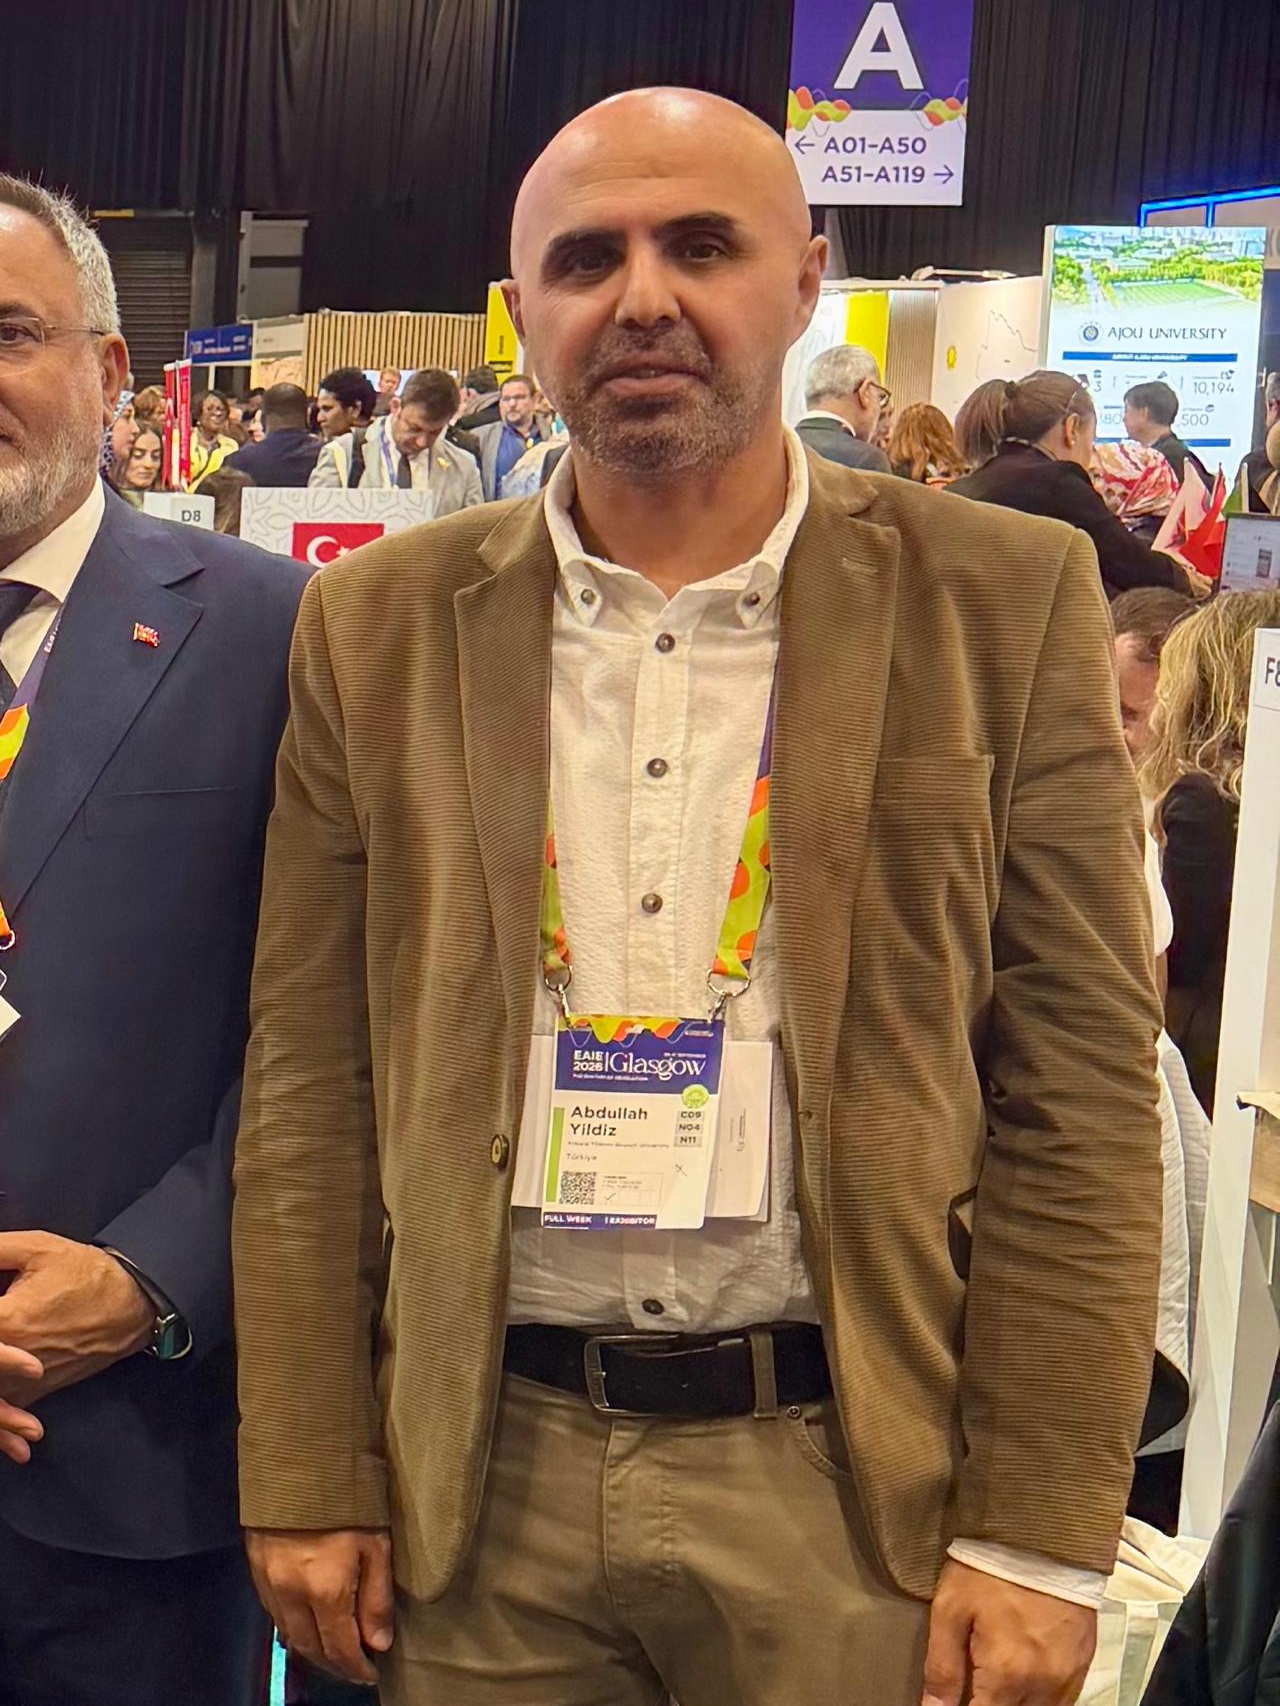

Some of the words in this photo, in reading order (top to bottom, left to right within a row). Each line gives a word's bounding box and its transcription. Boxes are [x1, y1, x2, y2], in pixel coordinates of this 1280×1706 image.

[833, 1, 924, 90] A
[824, 137, 927, 154] A01-A50
[821, 165, 926, 183] A51-A119
[1108, 327, 1143, 341] AJOU
[1149, 327, 1228, 340] UNIVERSITY
[181, 510, 201, 523] D8
[573, 1050, 603, 1061] EAIE
[609, 1052, 707, 1081] Glasgow
[571, 1106, 648, 1120] Abdullah
[570, 1123, 617, 1137] Yildiz
[544, 1214, 565, 1223] FULL
[566, 1215, 592, 1224] WEEK
